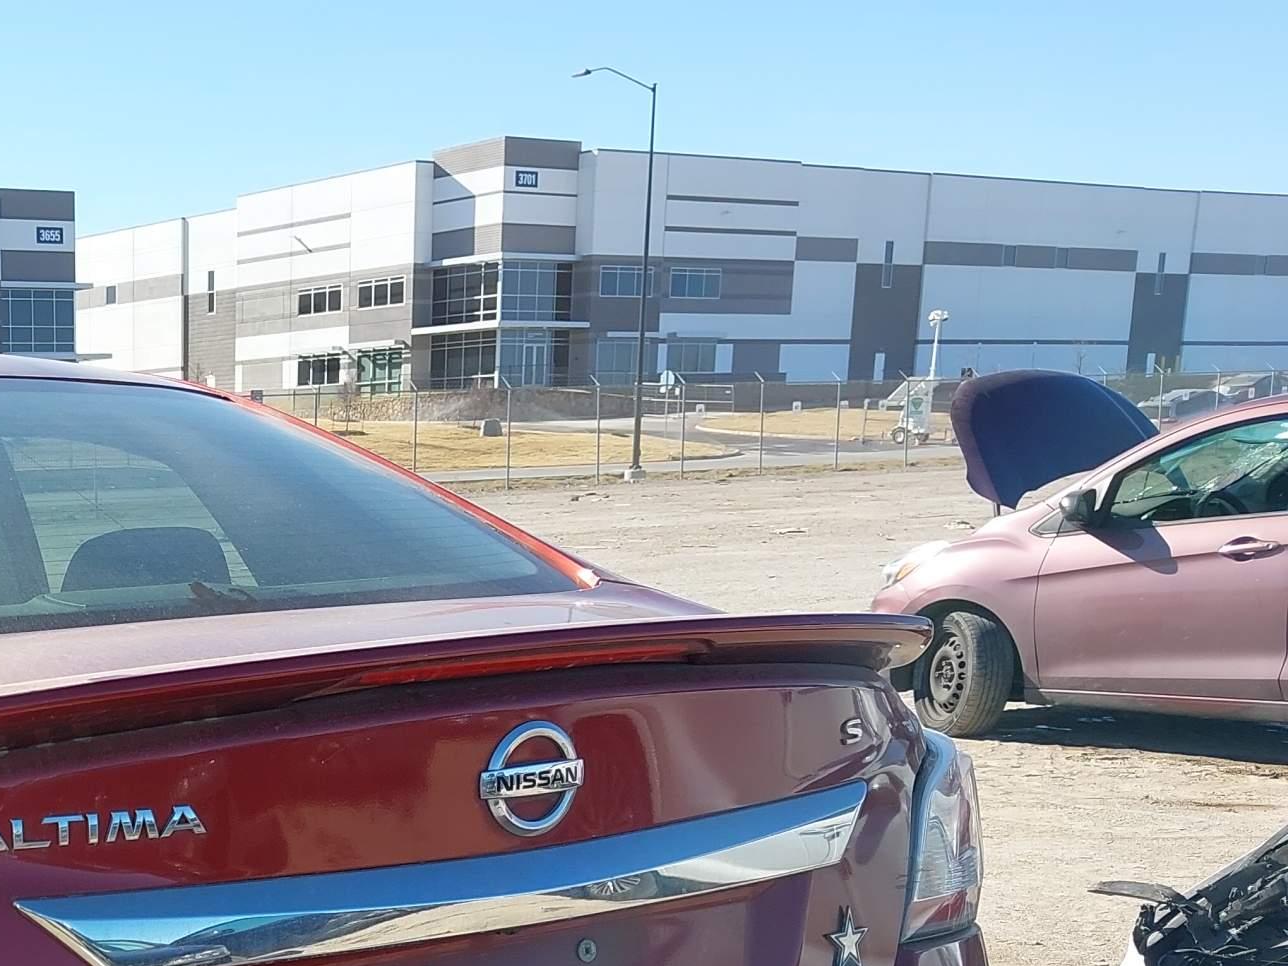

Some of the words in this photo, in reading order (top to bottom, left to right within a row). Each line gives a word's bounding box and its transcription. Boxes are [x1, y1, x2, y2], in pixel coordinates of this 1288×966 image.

[518, 173, 536, 185] 3701
[39, 229, 61, 242] 3655
[496, 765, 578, 792] NISSAN
